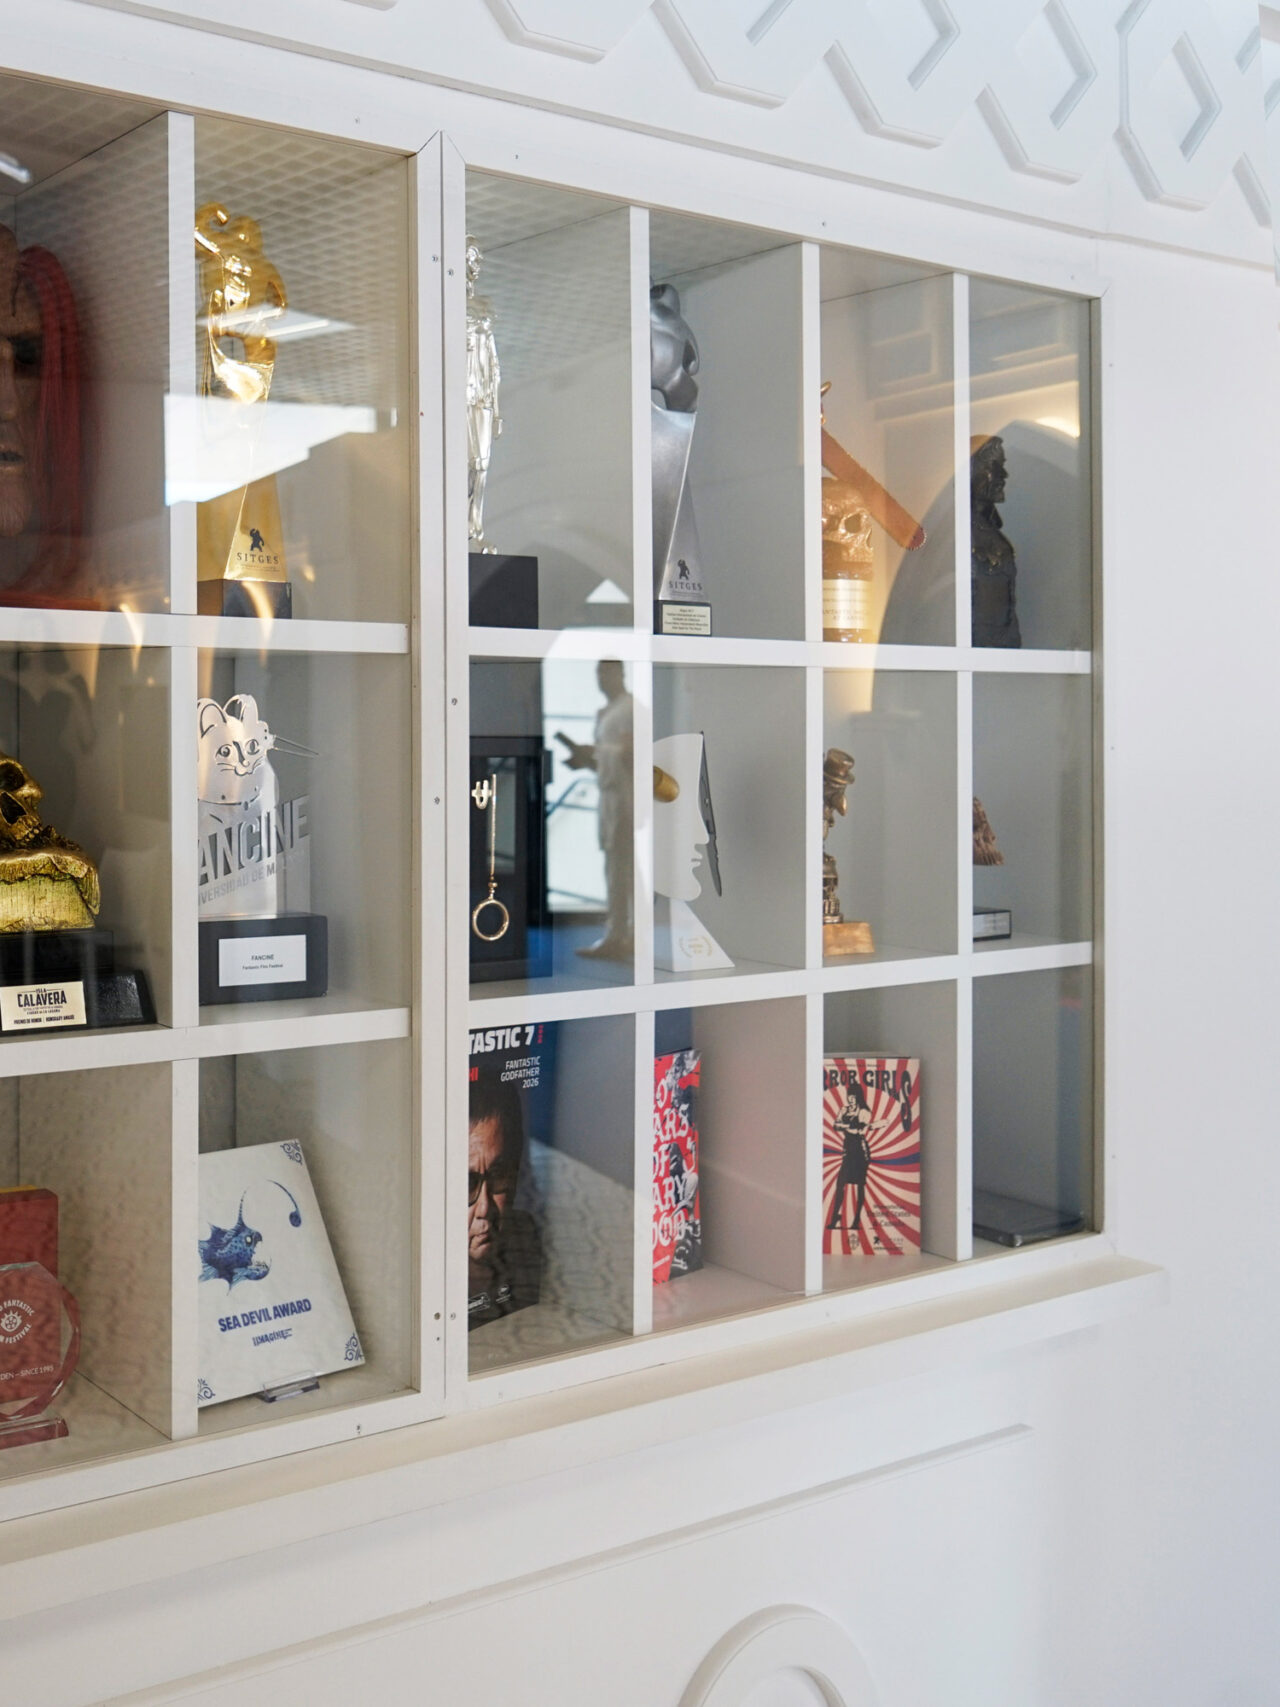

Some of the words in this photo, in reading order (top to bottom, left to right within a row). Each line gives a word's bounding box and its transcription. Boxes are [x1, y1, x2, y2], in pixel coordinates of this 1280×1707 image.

[236, 552, 279, 565] SITGES
[668, 581, 703, 591] SITGES
[17, 990, 67, 1008] CALAVERA
[525, 1025, 535, 1046] 7
[505, 1056, 541, 1071] FANTASTIC
[500, 1067, 540, 1082] GODFATHER
[862, 1070, 912, 1132] GIRLS
[3, 1299, 36, 1317] FANTASTIC
[218, 1315, 242, 1332] SEA
[240, 1307, 273, 1327] DEVIL
[272, 1298, 312, 1320] AWARD
[5, 1323, 32, 1344] FESTIVAL
[20, 1367, 39, 1377] SINCE
